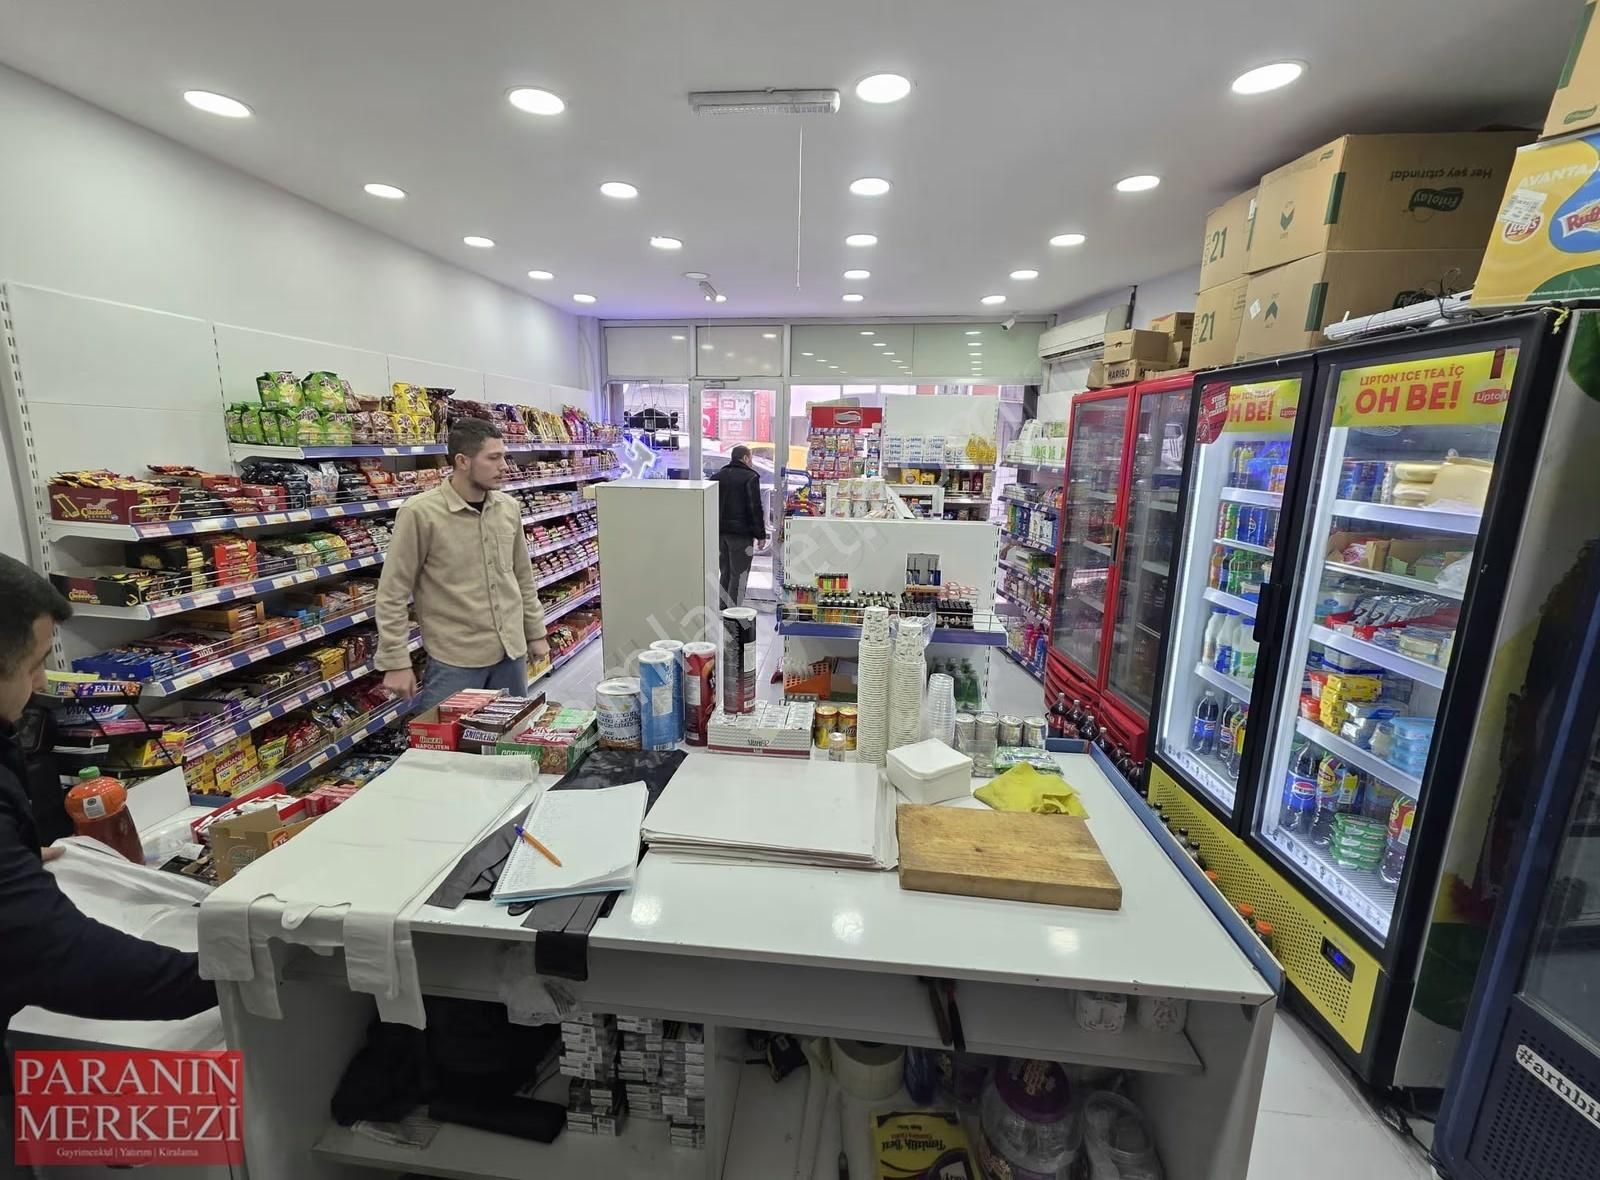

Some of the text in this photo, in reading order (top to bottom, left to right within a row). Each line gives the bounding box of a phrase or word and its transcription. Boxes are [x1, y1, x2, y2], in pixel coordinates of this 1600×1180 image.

[1209, 227, 1228, 263] 21
[1198, 311, 1216, 343] 21
[1107, 368, 1130, 380] HARIBO
[1359, 363, 1465, 386] LIPTON ICE TEA İÇ
[1355, 380, 1463, 415] OH BE!
[1244, 400, 1274, 423] BE!
[464, 729, 497, 742] SNICKERS
[215, 749, 246, 773] DARDANEL
